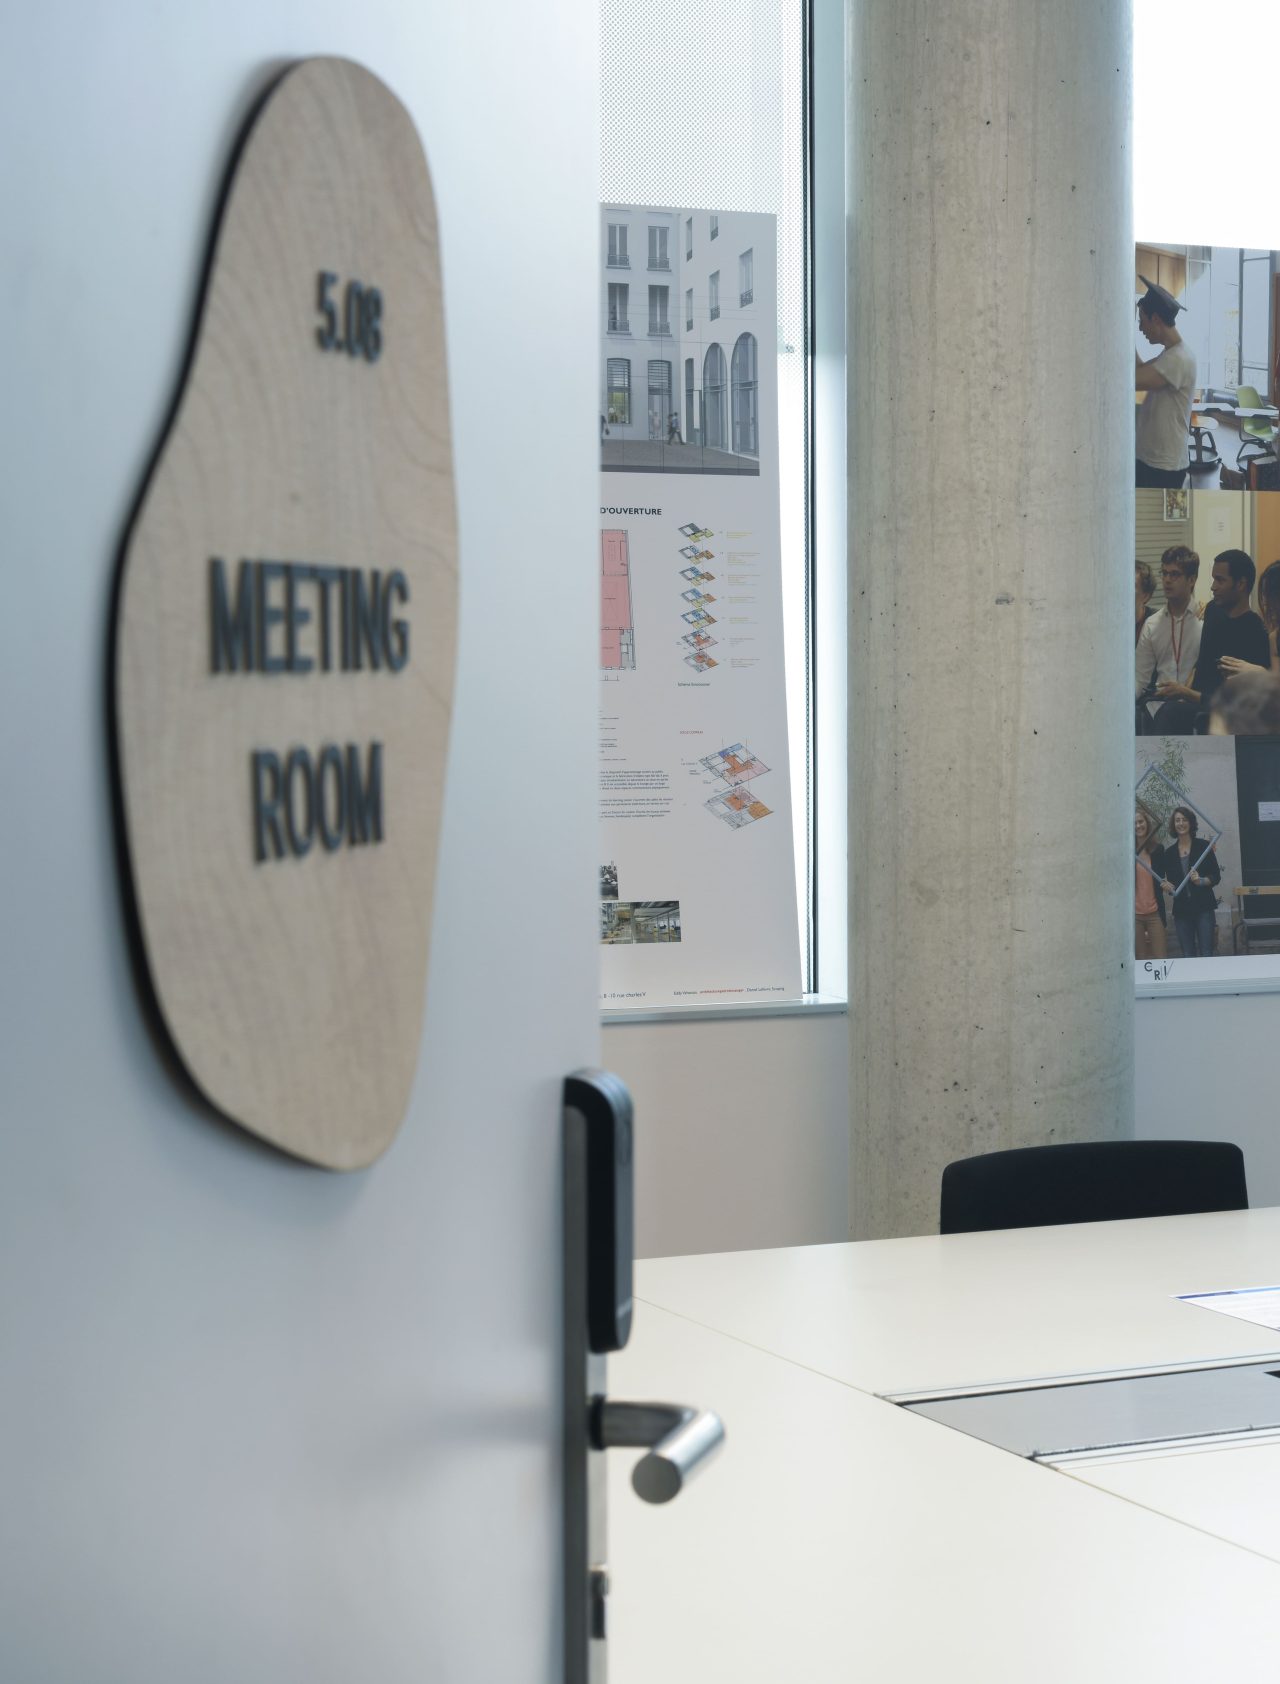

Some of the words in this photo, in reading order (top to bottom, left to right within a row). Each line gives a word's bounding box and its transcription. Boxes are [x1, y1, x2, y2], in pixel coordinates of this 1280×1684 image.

[314, 269, 383, 364] 5.08
[600, 507, 663, 516] D'OUVERTURE
[207, 555, 411, 677] MEETING
[249, 740, 384, 864] ROOM
